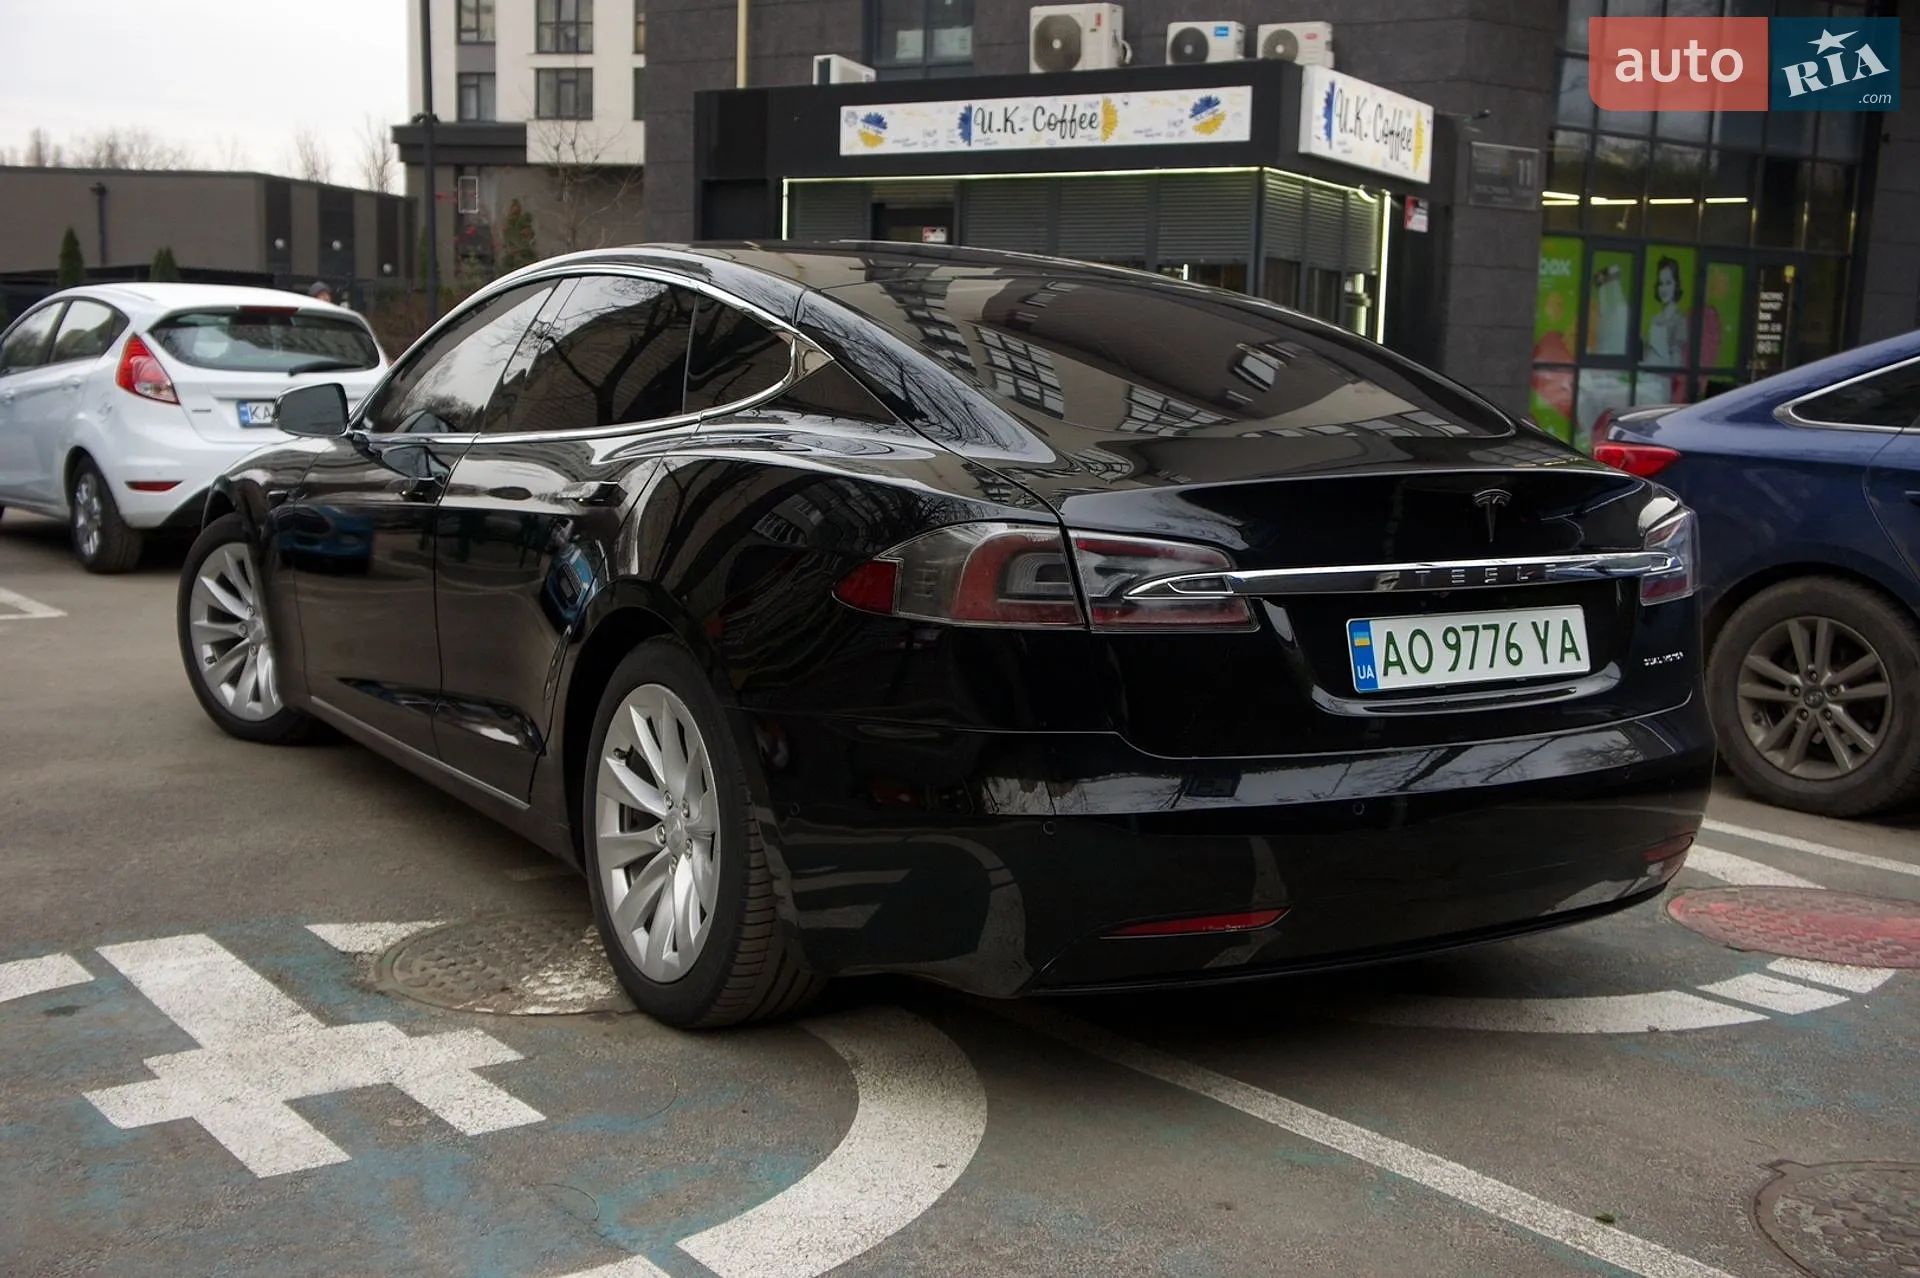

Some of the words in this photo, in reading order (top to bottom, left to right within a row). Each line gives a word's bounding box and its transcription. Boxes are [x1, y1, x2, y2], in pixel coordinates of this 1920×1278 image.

[973, 106, 1024, 134] U.K.
[1032, 104, 1099, 140] Coffee
[1335, 88, 1368, 141] U.K.
[1373, 102, 1413, 162] Coffee
[1357, 663, 1375, 680] UA
[1383, 628, 1433, 677] AO
[1442, 621, 1523, 673] 9776
[1531, 619, 1581, 664] YA
